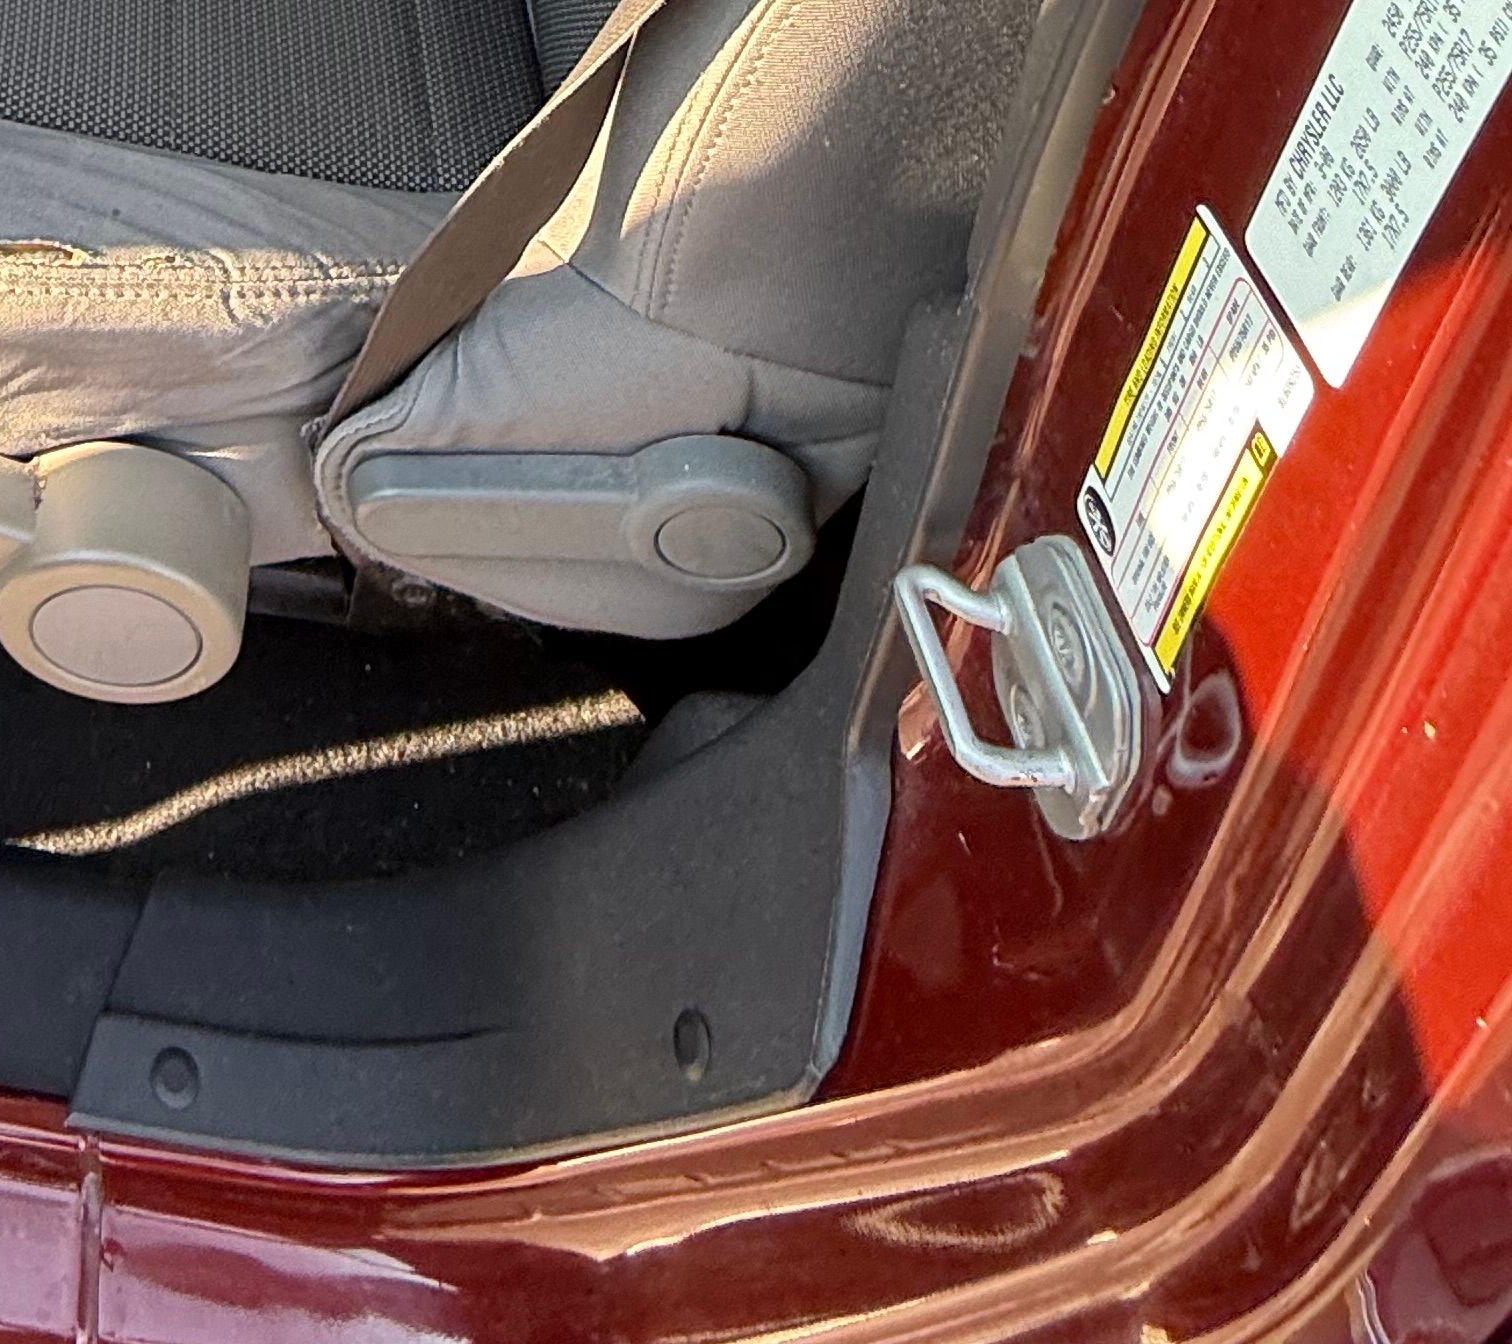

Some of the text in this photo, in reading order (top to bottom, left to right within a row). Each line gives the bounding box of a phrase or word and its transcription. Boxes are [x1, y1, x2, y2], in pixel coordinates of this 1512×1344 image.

[1382, 0, 1404, 38] 2450
[1289, 101, 1332, 179] CHRYSLER
[1321, 73, 1344, 111] LLC
[1340, 156, 1355, 181] KG
[1364, 106, 1380, 132] LB
[1352, 159, 1378, 205] 17X7.5
[1415, 48, 1435, 80] 240
[1370, 200, 1385, 225] KG
[1395, 149, 1411, 175] LB
[1433, 27, 1475, 104] P255/75R17
[1382, 203, 1409, 251] 17X7.5
[1449, 91, 1469, 124] 240
[1479, 39, 1496, 67] 35
